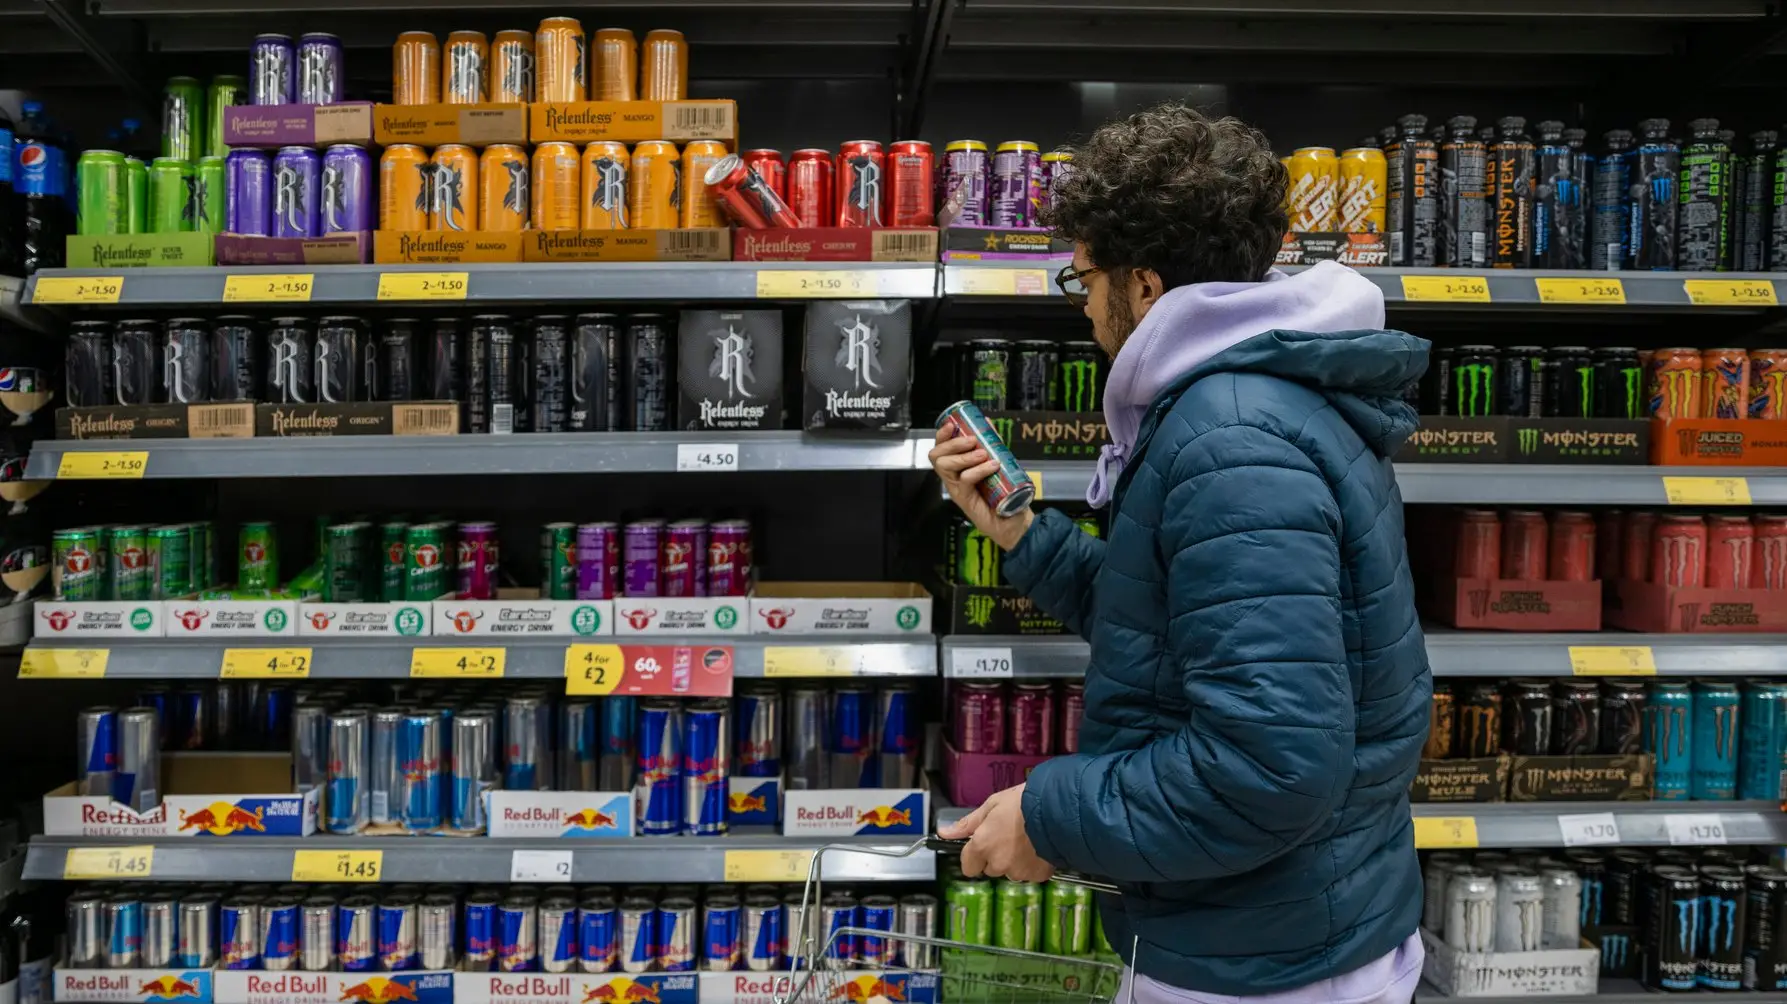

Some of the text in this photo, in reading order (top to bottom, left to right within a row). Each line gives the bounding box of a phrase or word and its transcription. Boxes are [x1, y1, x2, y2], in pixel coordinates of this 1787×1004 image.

[232, 116, 277, 136] Relentless
[382, 116, 427, 135] Relentless
[545, 106, 611, 132] Relentless
[399, 232, 465, 261] Relentless
[536, 230, 605, 257] Relentless
[744, 234, 857, 261] Relentless CHERRY
[92, 241, 152, 268] Relentless
[1336, 252, 1388, 264] ALERT
[843, 314, 882, 389] R
[717, 324, 756, 398] R
[825, 388, 891, 418] Relentless
[699, 397, 764, 428] Relentless
[69, 412, 176, 439] Relentless ORIGIN
[271, 408, 379, 436] Relentless ORIGIN
[1021, 419, 1108, 443] MONST
[1543, 429, 1639, 447] MONSTER
[1698, 432, 1743, 443] JUICED
[1043, 446, 1096, 454] ENER
[697, 453, 734, 465] £4.50
[499, 608, 552, 621] Carabao
[490, 624, 554, 632] ENERGY DRINK
[268, 656, 278, 671] 4
[291, 656, 306, 671] £2
[457, 656, 467, 670] 4
[481, 656, 495, 670] £2
[584, 652, 610, 664] 4 for
[977, 659, 1009, 671] £1.70
[585, 657, 662, 685] £2 60p
[1416, 773, 1490, 785] MONSTER
[1547, 767, 1627, 782] MONSTER
[1428, 786, 1476, 796] MULE
[504, 807, 560, 820] Red Bull
[797, 806, 853, 820] Red Bull
[82, 827, 168, 836] ENERGY DRINK
[1584, 825, 1615, 838] £1.70
[1690, 826, 1721, 838] £1.70
[108, 858, 147, 873] £1.45
[338, 861, 377, 877] £1.45
[556, 862, 569, 875] £2
[1498, 966, 1583, 979] MONSTER
[1660, 961, 1696, 974] MONS
[66, 976, 129, 990] Red Bull
[248, 975, 327, 993] Red Bull
[490, 977, 570, 996] Red Bull
[735, 976, 774, 994] Red
